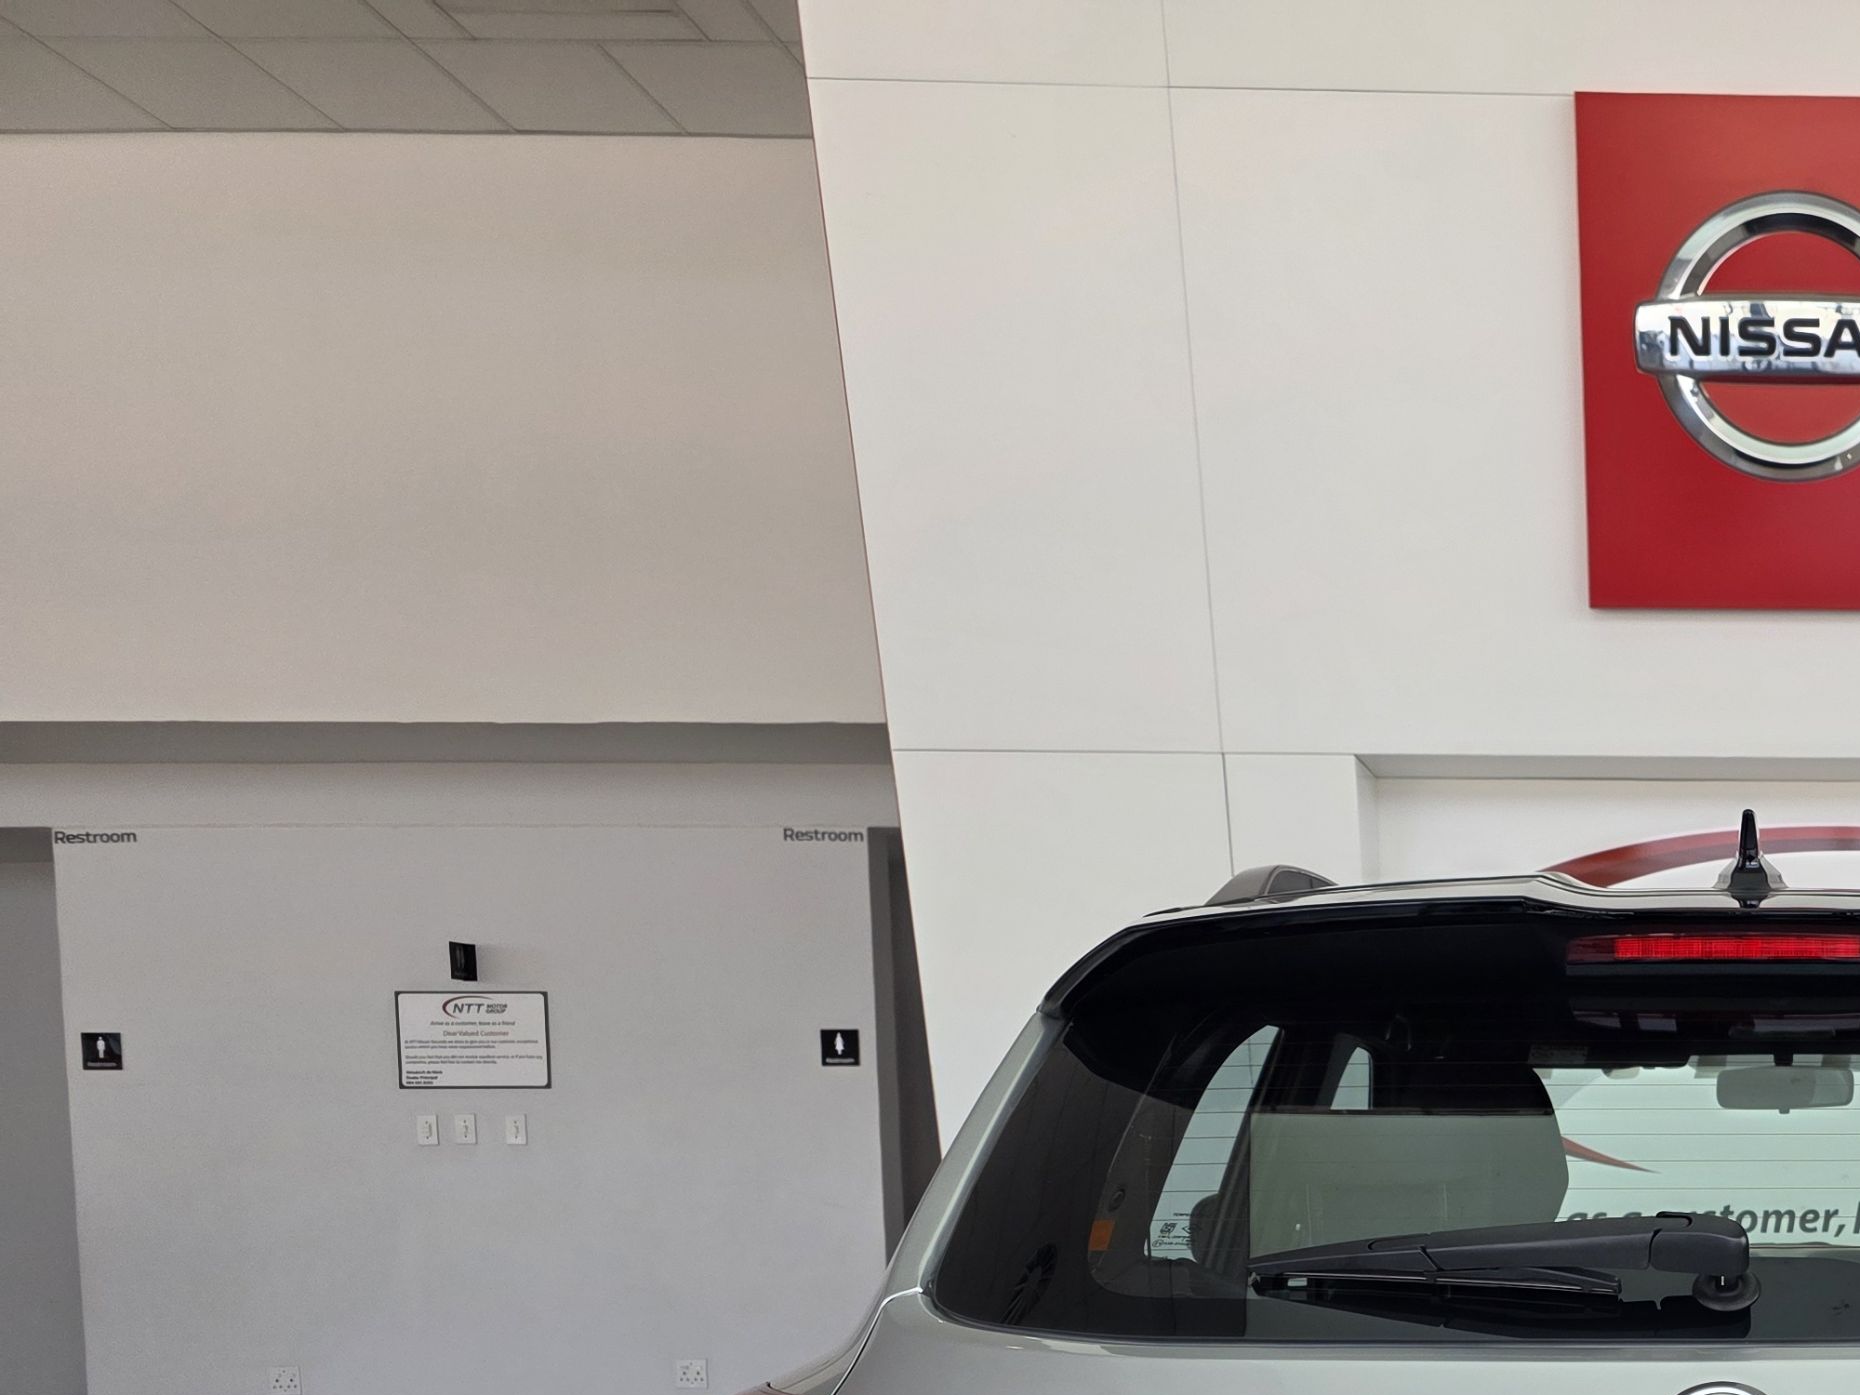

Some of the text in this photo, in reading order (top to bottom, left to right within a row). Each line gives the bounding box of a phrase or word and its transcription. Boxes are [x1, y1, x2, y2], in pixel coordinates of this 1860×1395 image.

[54, 831, 138, 844] Restroom
[783, 828, 864, 842] Restroom
[452, 1003, 485, 1014] NTT
